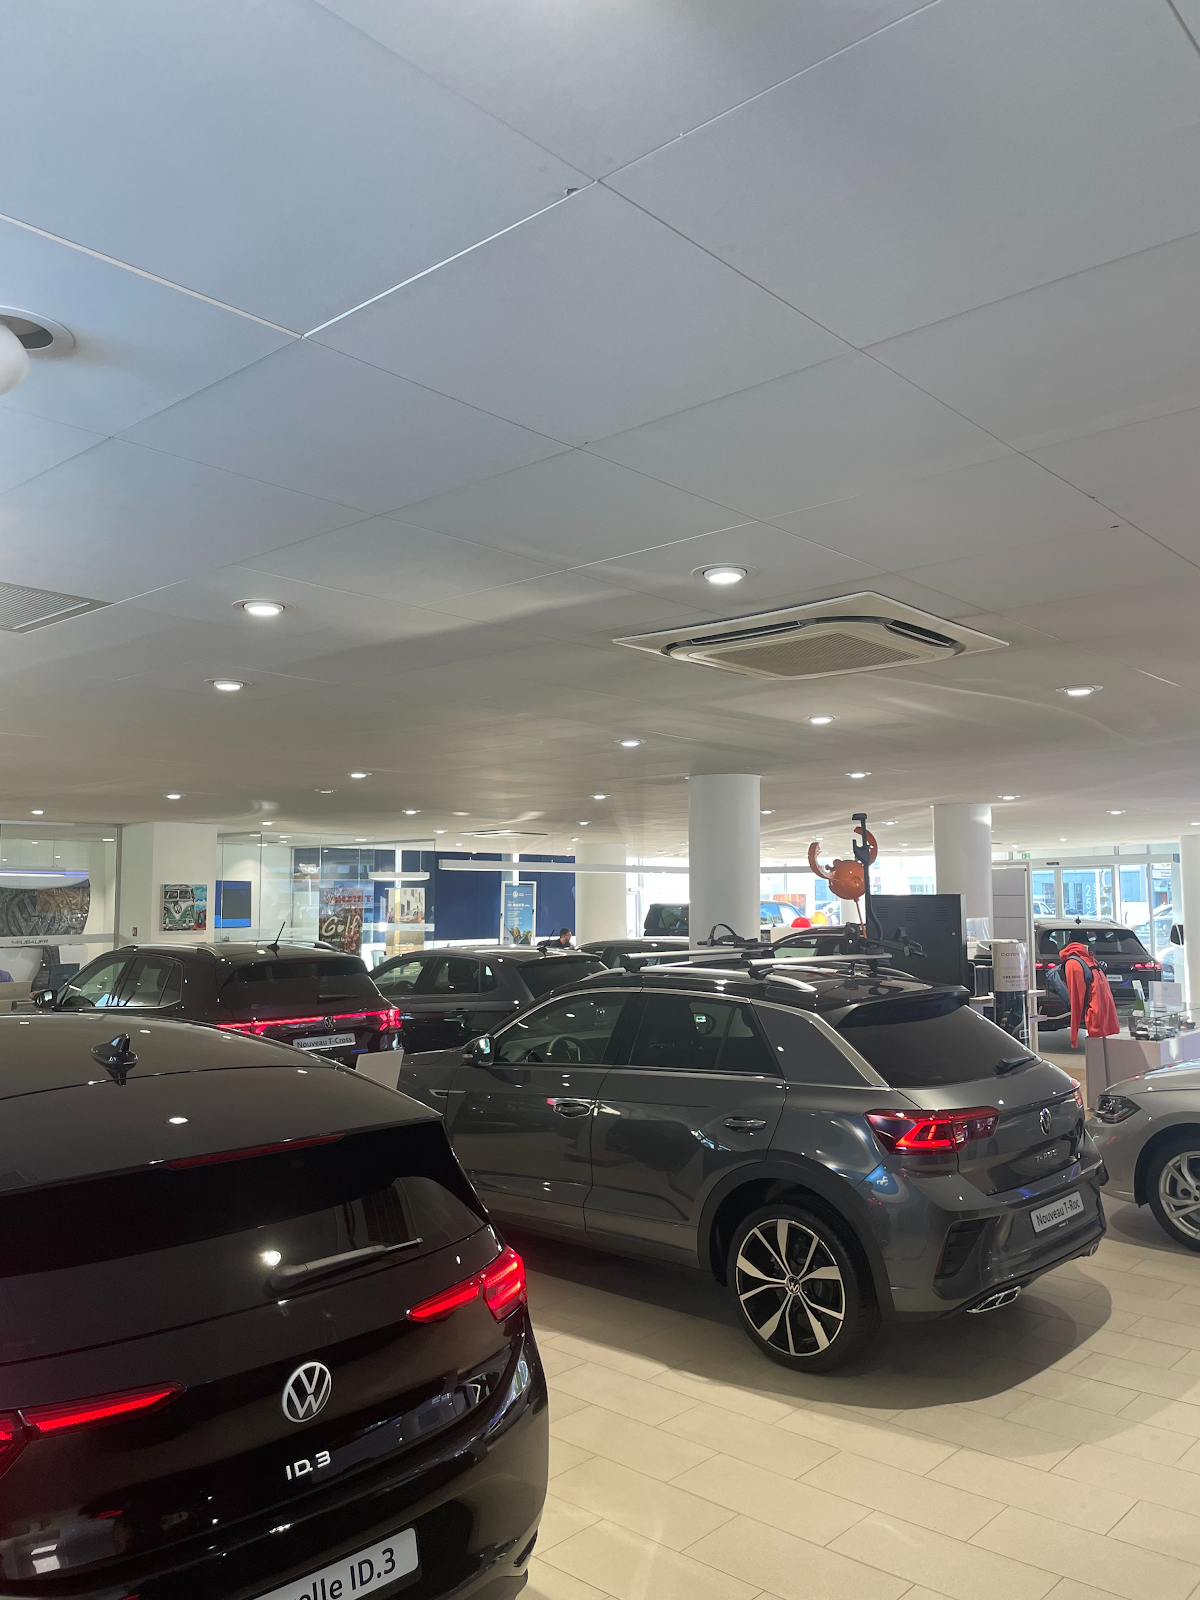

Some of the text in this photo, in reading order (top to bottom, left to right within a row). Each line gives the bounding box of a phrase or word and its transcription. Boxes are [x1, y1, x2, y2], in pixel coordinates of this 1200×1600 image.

[296, 1036, 353, 1048] Nouveau T-Cross
[1035, 1199, 1081, 1227] Nouveau T-Roc
[349, 1547, 396, 1591] ID.3
